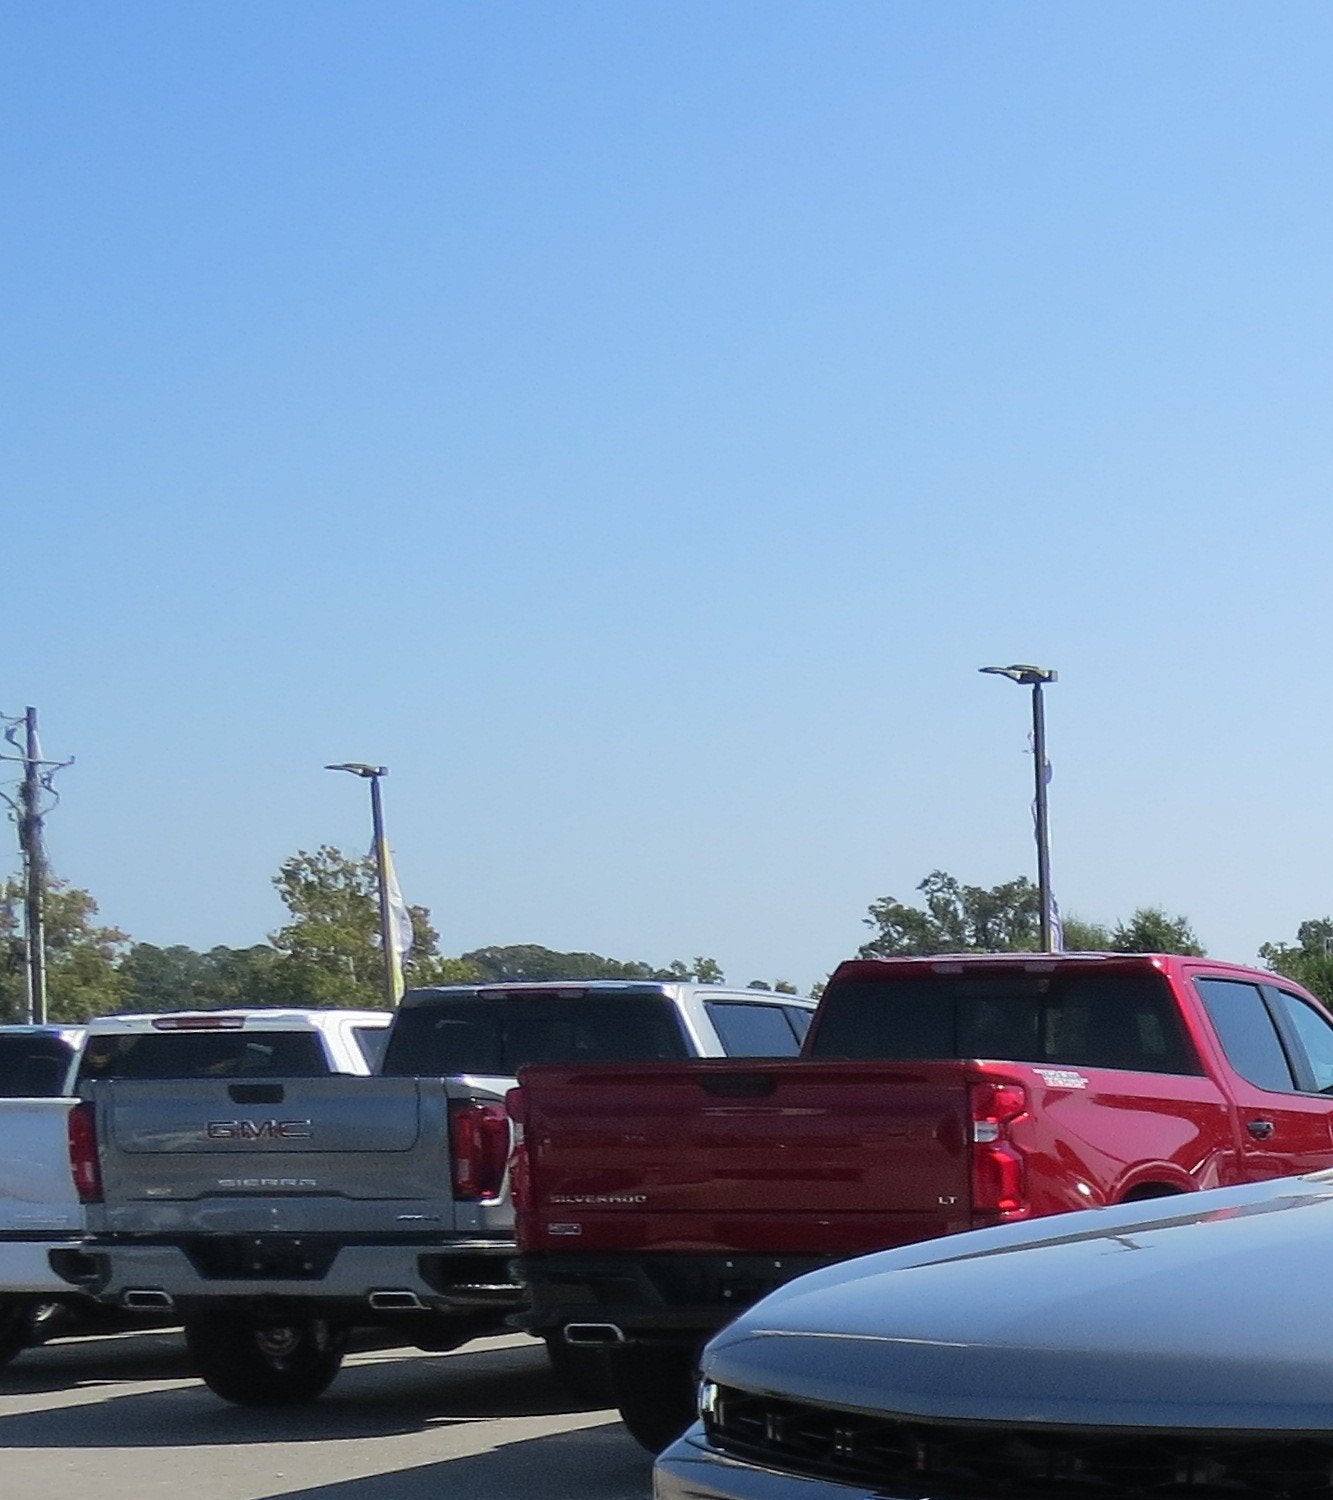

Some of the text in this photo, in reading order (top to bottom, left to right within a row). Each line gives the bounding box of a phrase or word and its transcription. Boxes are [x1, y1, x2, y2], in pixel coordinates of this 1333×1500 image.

[207, 1119, 313, 1139] GMC
[550, 1194, 648, 1204] SILVERADO
[938, 1196, 958, 1205] LT
